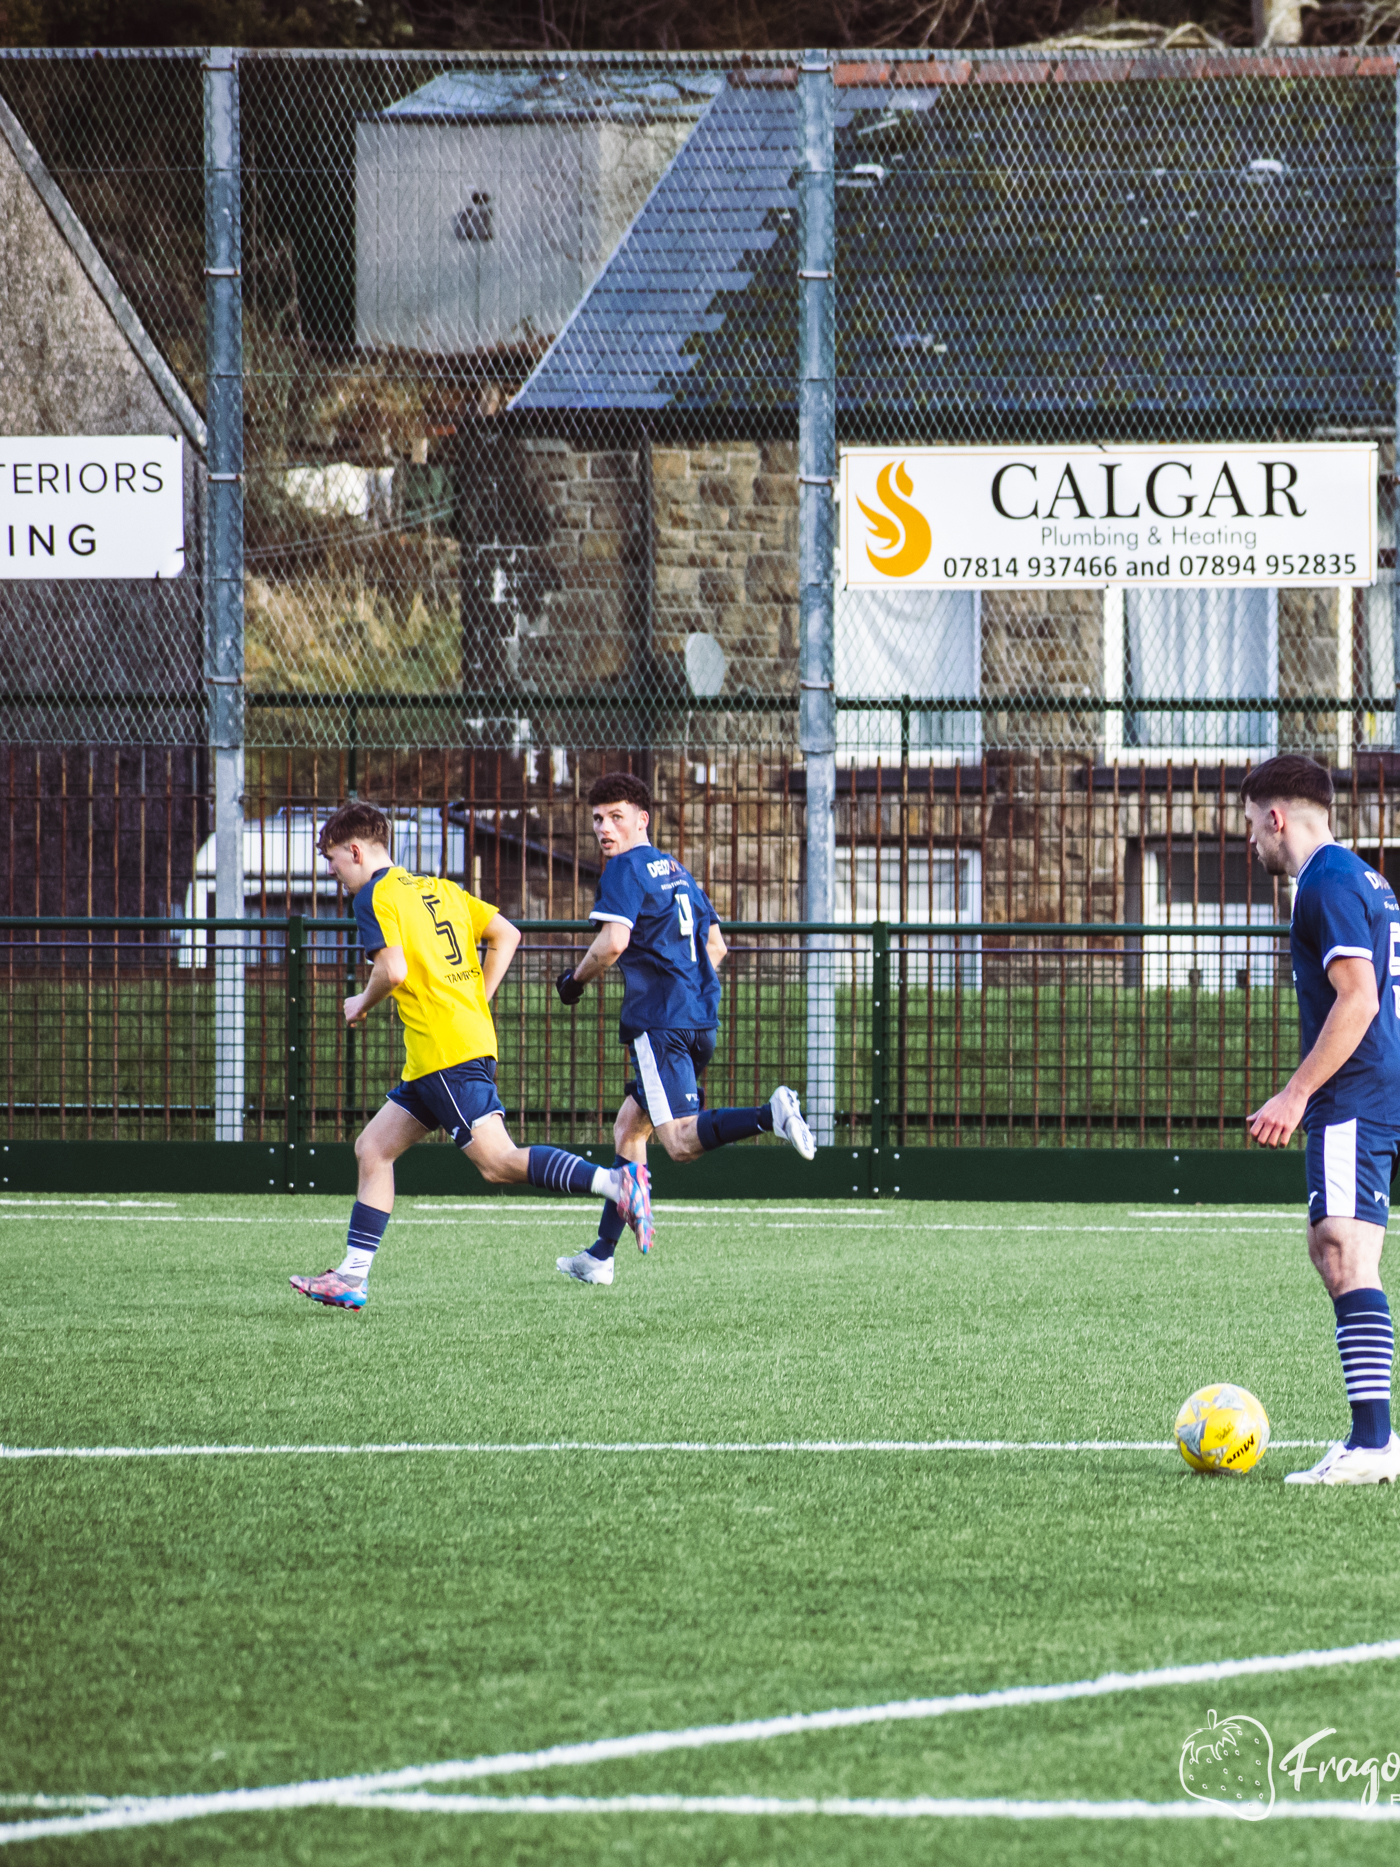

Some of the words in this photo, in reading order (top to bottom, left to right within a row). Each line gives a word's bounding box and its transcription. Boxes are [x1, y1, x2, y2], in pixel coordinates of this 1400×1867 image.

[0, 462, 163, 493] ERIORS
[992, 461, 1306, 519] CALGAR
[9, 524, 95, 556] ING
[1042, 526, 1138, 550] Plumbing
[1148, 527, 1161, 544] &
[1173, 527, 1256, 548] Heating
[944, 558, 1018, 577] 07814
[1028, 557, 1116, 576] 937466
[1127, 555, 1169, 576] and
[1180, 556, 1255, 575] 07894
[1266, 554, 1355, 574] 952835
[421, 894, 463, 966] 5
[674, 893, 698, 963] 4
